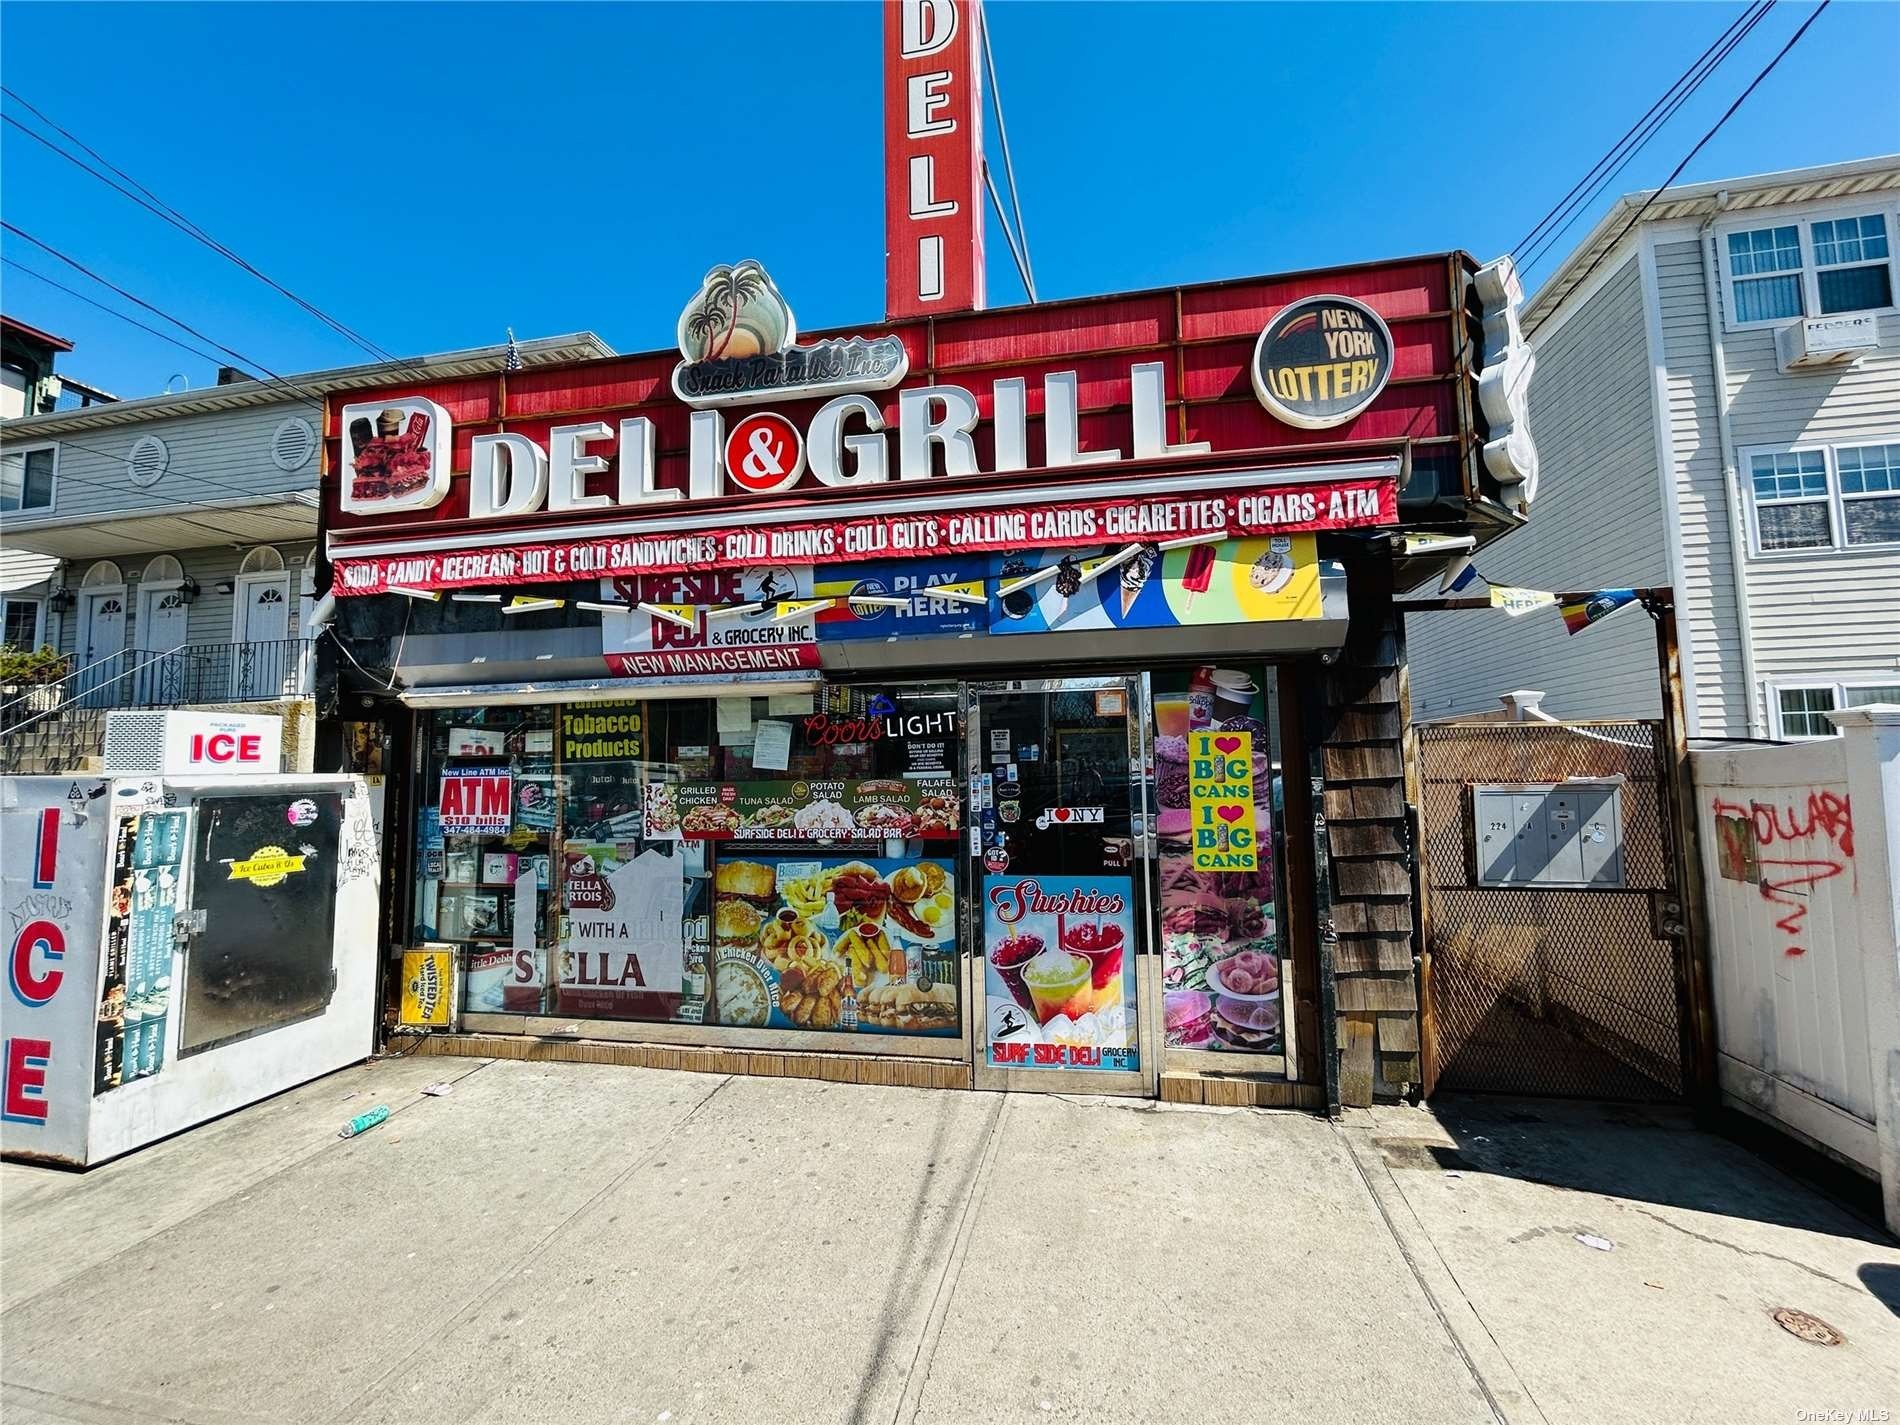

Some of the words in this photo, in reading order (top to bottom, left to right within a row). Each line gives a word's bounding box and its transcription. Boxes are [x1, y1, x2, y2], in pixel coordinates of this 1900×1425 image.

[899, 0, 959, 300] DELI
[1321, 308, 1364, 330] NEW
[1324, 330, 1376, 360] YORK
[686, 362, 747, 395] Snack
[846, 349, 890, 378] Inc.
[1268, 358, 1380, 402] LOTTERY
[469, 409, 726, 518] DELI
[806, 362, 1211, 487] GRILL
[343, 566, 379, 588] SODA
[386, 559, 435, 585] CANDY
[441, 551, 516, 581] ICECREAM
[522, 548, 552, 576] HOT
[570, 544, 607, 572] COLD
[610, 536, 717, 568] SANDWICHES
[725, 532, 767, 561] COLD
[771, 528, 836, 558] DRINKS
[844, 523, 888, 553] COLD
[892, 521, 938, 550] CUTS
[949, 513, 1027, 546] CALLING
[1031, 508, 1097, 539] CARDS
[1104, 498, 1226, 536] CIGARETTES
[1238, 491, 1316, 526] CIGARS
[1328, 488, 1380, 520] ATM
[612, 573, 744, 604] SURFSIDE
[894, 573, 958, 595] PLAY
[895, 596, 970, 618] HERE.
[712, 632, 723, 645] &
[725, 626, 784, 645] GROCERY
[788, 625, 813, 642] INC.
[622, 654, 665, 675] NEW
[669, 648, 801, 673] MANAGEMENT
[563, 714, 641, 735] Tobacco
[804, 714, 886, 745] Coors
[887, 711, 957, 737] LIGHT
[190, 734, 262, 764] ICE
[566, 738, 640, 759] Products
[1199, 736, 1212, 756] I
[441, 768, 460, 776] New
[461, 768, 478, 776] Line
[479, 768, 496, 776] ATM
[680, 786, 717, 795] GRILLED
[810, 781, 845, 791] POTATO
[916, 779, 957, 788] FALAFEL
[921, 788, 953, 798] SALAD
[1193, 785, 1250, 799] CANS
[440, 777, 511, 816] ATM
[679, 796, 718, 805] CHICKEN
[739, 797, 762, 805] TUNA
[764, 796, 794, 805] SALAD
[812, 791, 843, 799] SALAD
[853, 795, 878, 804] LAMB
[880, 794, 911, 803] SALAD
[645, 784, 653, 837] SALADS
[1046, 808, 1054, 822] I
[1071, 808, 1102, 822] NY
[1202, 805, 1214, 825] I
[475, 816, 505, 825] bills
[1490, 822, 1506, 831] 224
[1527, 822, 1533, 831] A
[1560, 822, 1566, 831] B
[1594, 822, 1600, 831] C
[443, 826, 506, 835] 347-484-4984
[733, 828, 775, 839] SURFSIDE
[777, 828, 797, 838] DELI
[807, 828, 848, 839] GROCERY
[851, 828, 882, 838] SALAD
[883, 828, 903, 838] BAR
[677, 840, 700, 849] ATM
[240, 864, 250, 872] Ice
[252, 862, 275, 872] Cubes
[1103, 859, 1121, 867] PULL
[1197, 853, 1255, 868] CANS
[988, 878, 1126, 924] Slushies
[578, 921, 615, 938] WITH
[619, 923, 629, 939] A
[1, 806, 67, 1127] ICE
[471, 955, 488, 968] ittle
[489, 953, 514, 965] Debb
[515, 950, 535, 983] S
[418, 964, 426, 981] Hard
[423, 954, 438, 1000] TWISTED
[722, 946, 757, 965] Chicken
[757, 958, 775, 982] Over
[768, 982, 781, 1008] Rice
[419, 982, 427, 997] Iced
[420, 1000, 436, 1020] TEA
[992, 1042, 1031, 1064] SURF
[1033, 1043, 1068, 1065] SIDE
[1069, 1045, 1101, 1066] DELI
[1102, 1046, 1138, 1057] GROCERY
